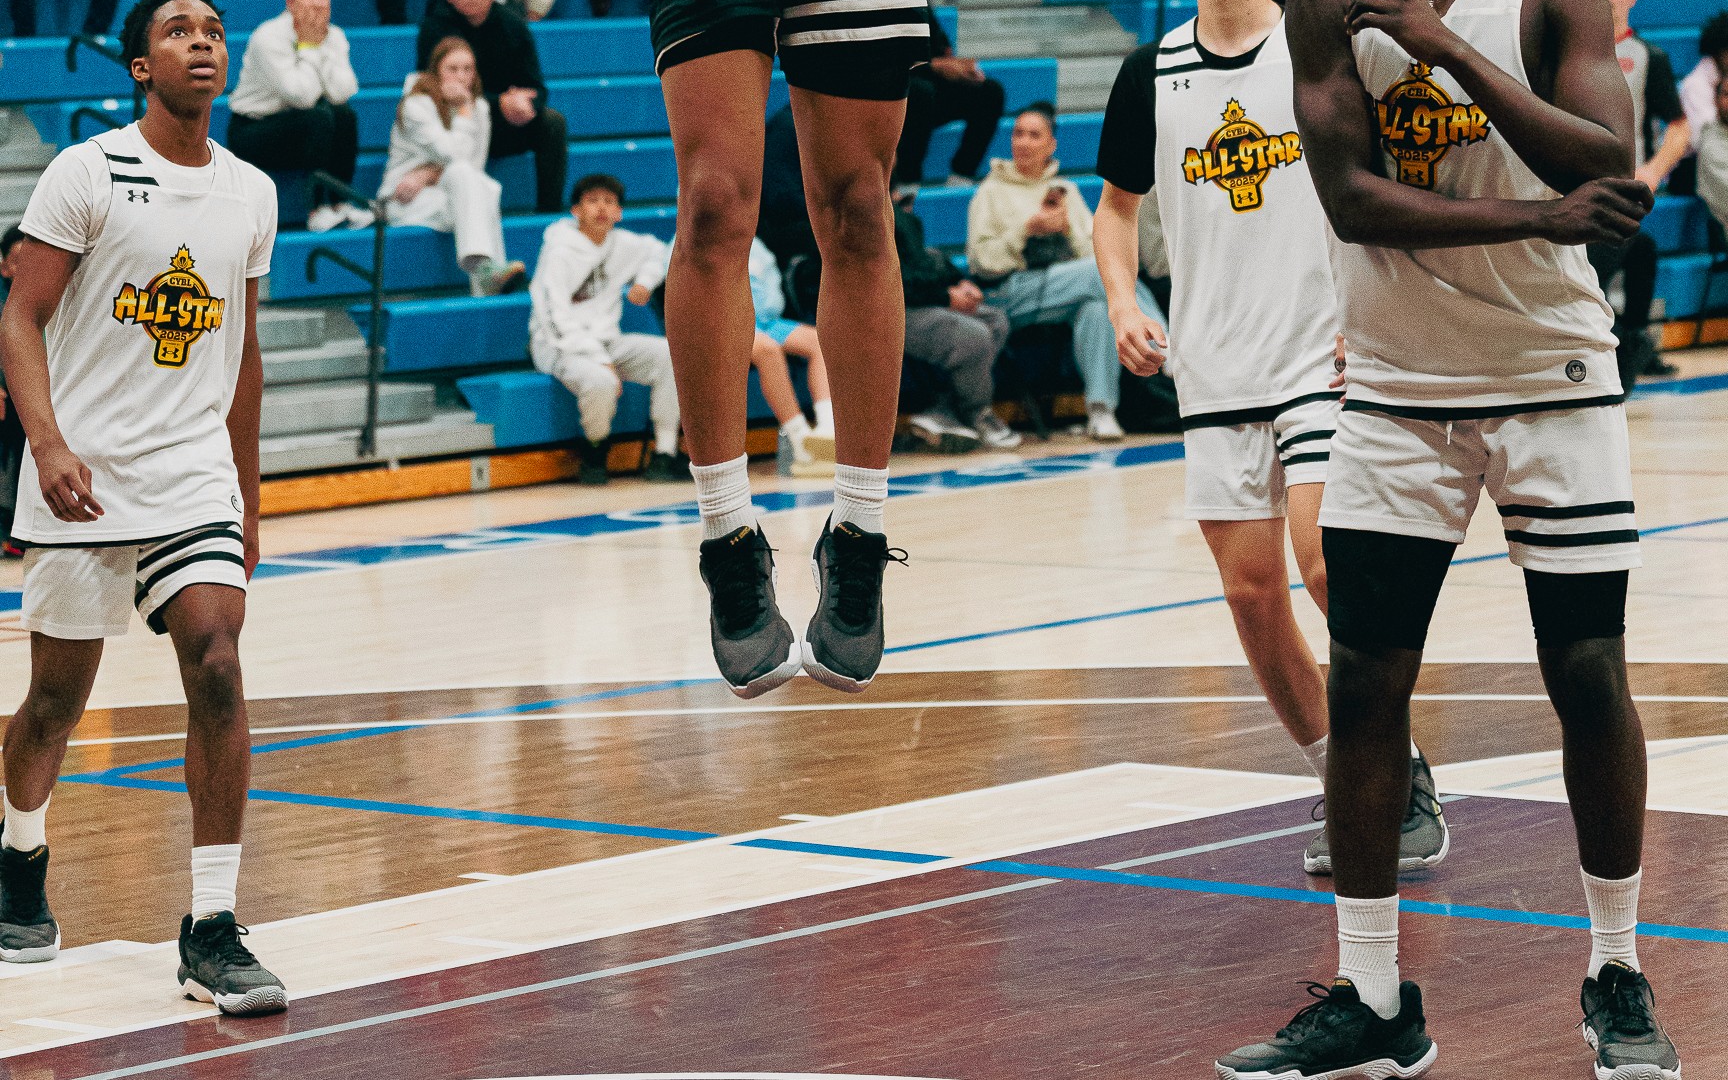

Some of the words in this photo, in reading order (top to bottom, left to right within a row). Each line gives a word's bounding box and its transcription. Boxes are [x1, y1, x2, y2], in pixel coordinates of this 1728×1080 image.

[1377, 104, 1489, 146] LL-STAR
[1225, 126, 1248, 138] CYBL
[1182, 132, 1302, 184] ALL-STAR
[1396, 150, 1430, 161] 2025
[1229, 176, 1256, 188] 2025
[169, 277, 192, 287] CYBL
[159, 330, 187, 341] 2025
